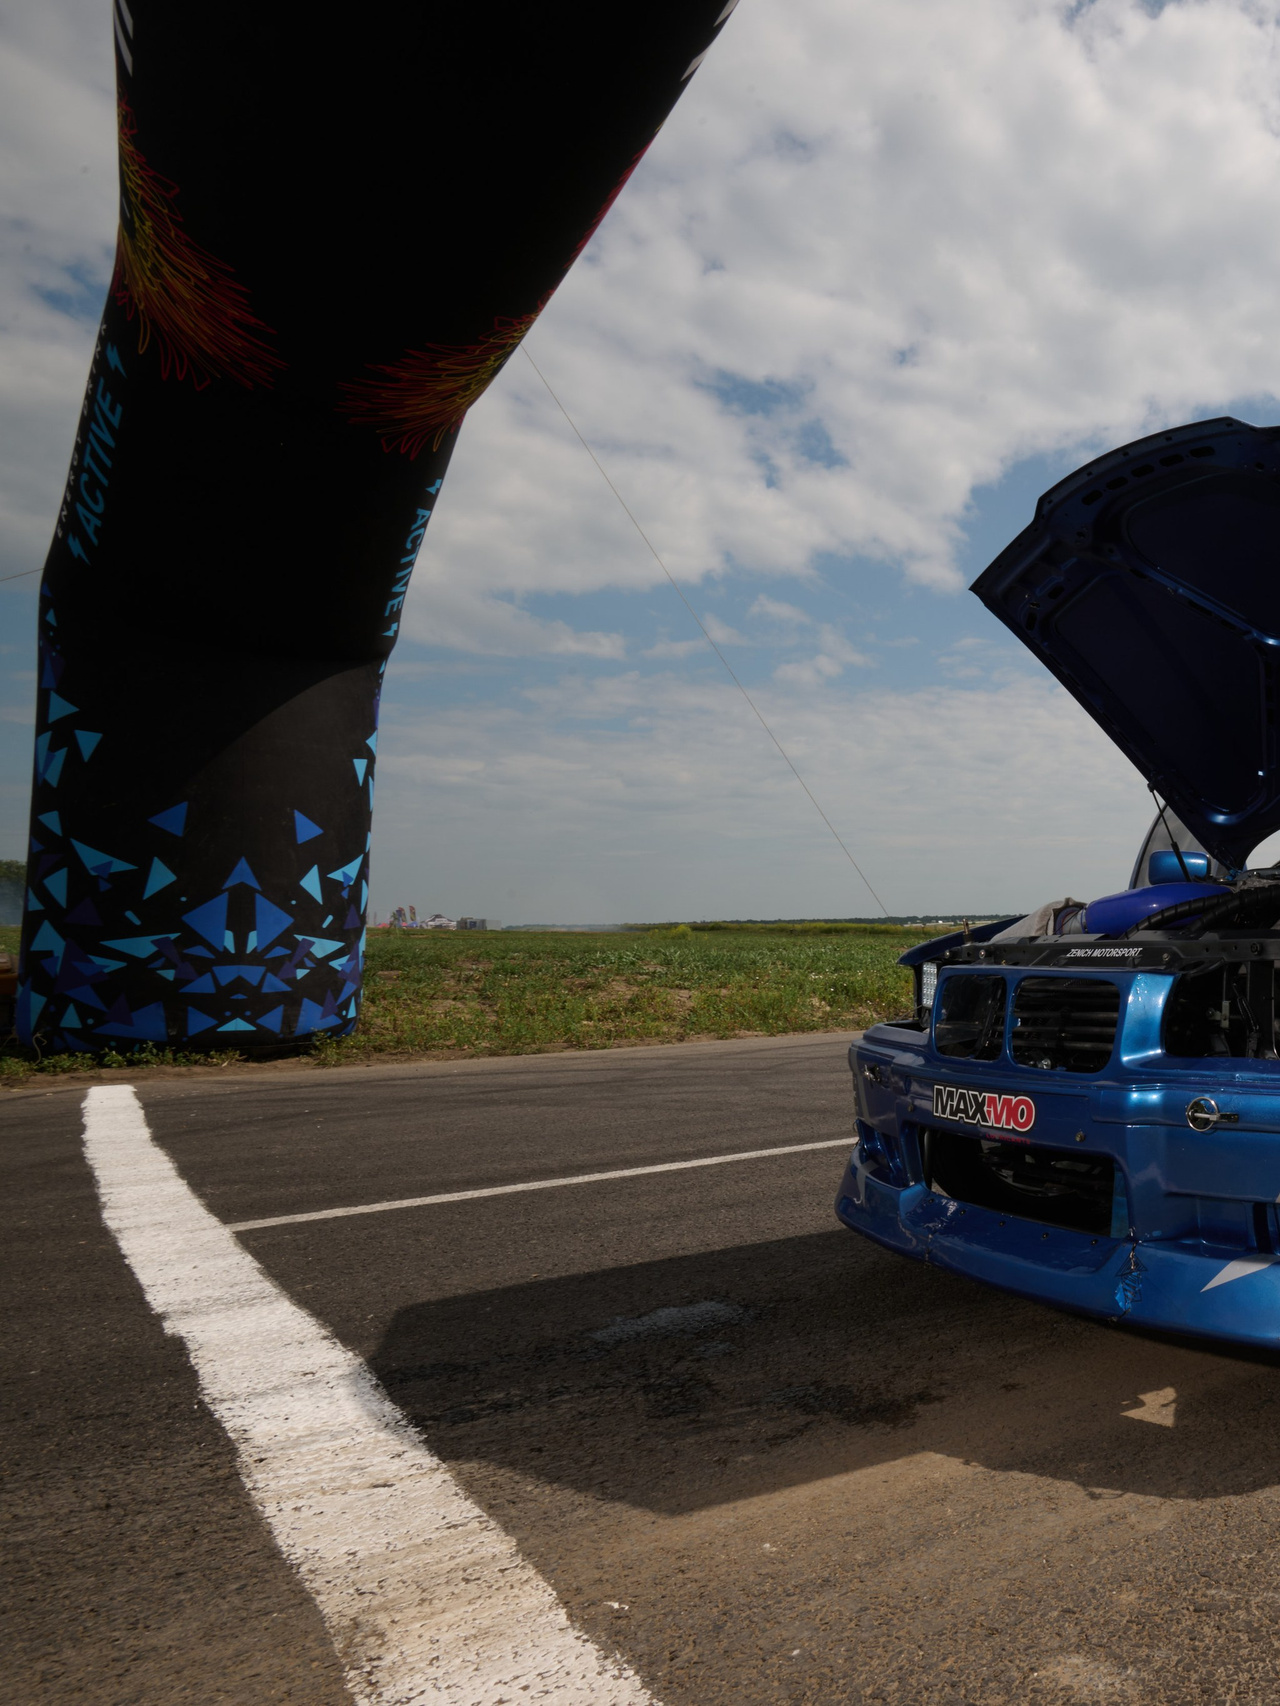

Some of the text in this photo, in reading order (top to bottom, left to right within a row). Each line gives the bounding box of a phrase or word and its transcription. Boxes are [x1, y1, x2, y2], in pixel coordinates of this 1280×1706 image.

[76, 376, 123, 547] ACTIVE
[384, 507, 432, 617] ACTIVE
[1066, 947, 1143, 957] ZENICH MOTORSPORT
[933, 1085, 1036, 1132] MAXMO
